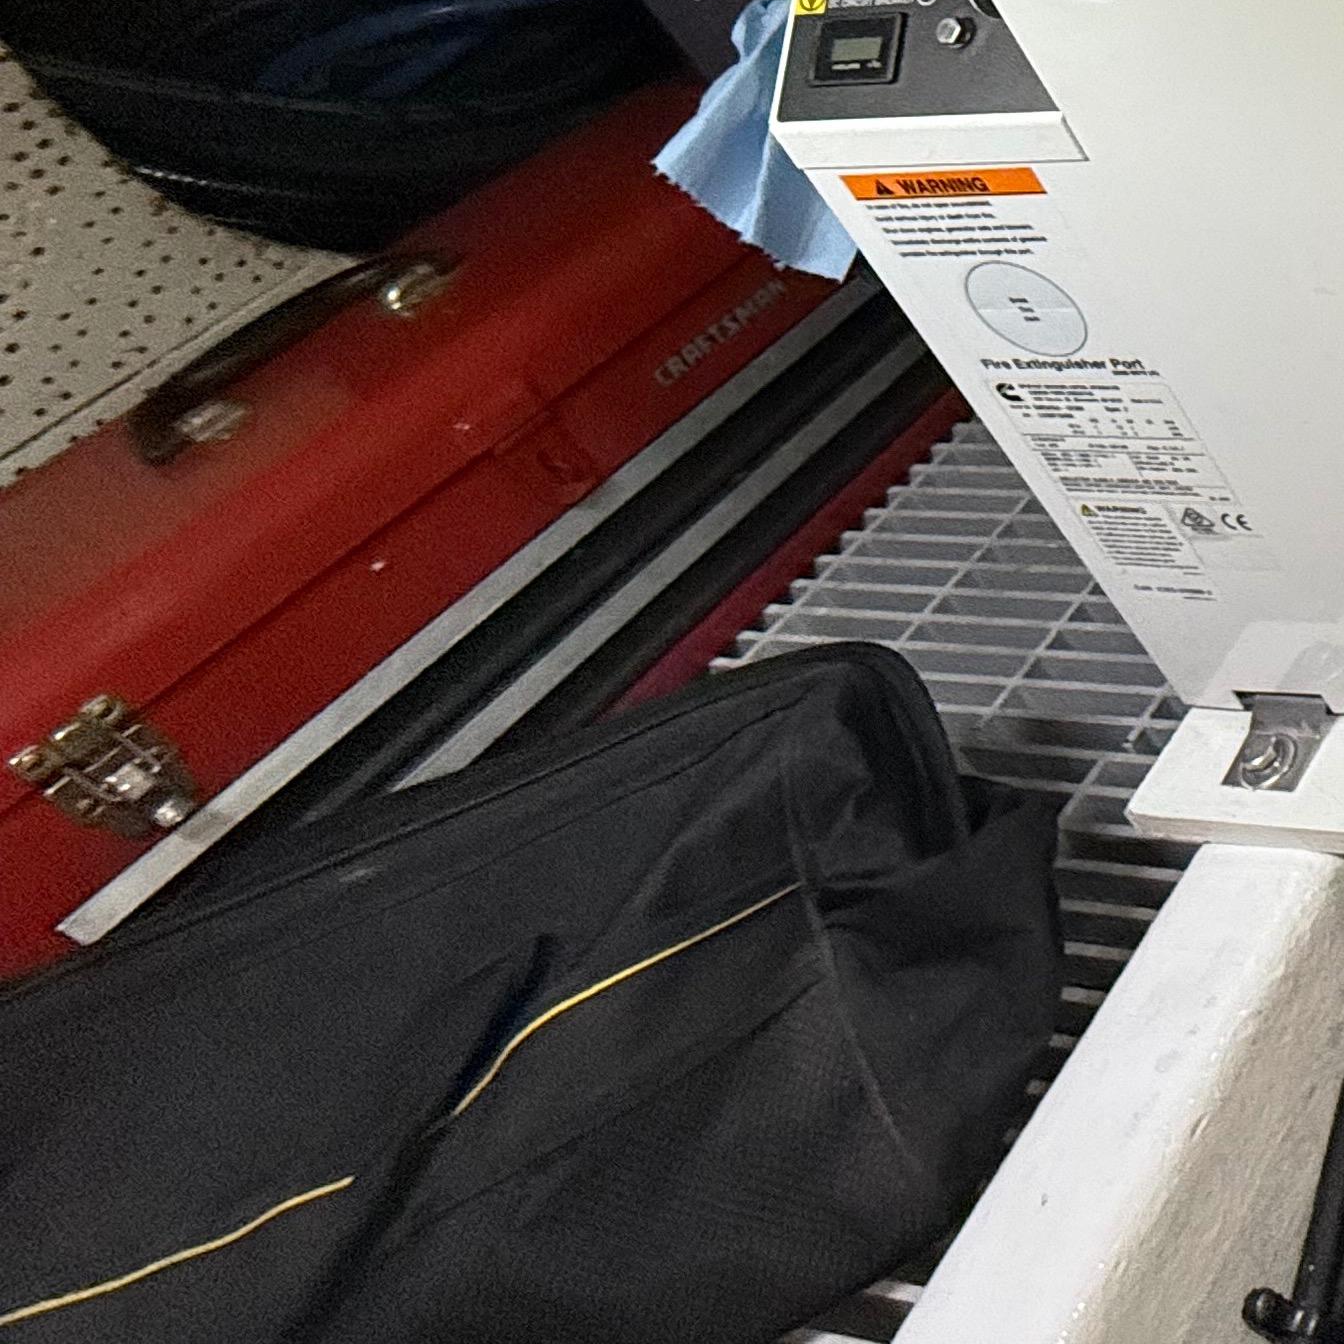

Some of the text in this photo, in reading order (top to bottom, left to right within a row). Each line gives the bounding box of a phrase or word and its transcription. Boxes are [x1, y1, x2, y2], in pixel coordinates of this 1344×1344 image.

[896, 177, 990, 194] WARNING
[655, 280, 784, 385] CRAFTSMAN
[980, 358, 1145, 371] Fire Extinguisher Port
